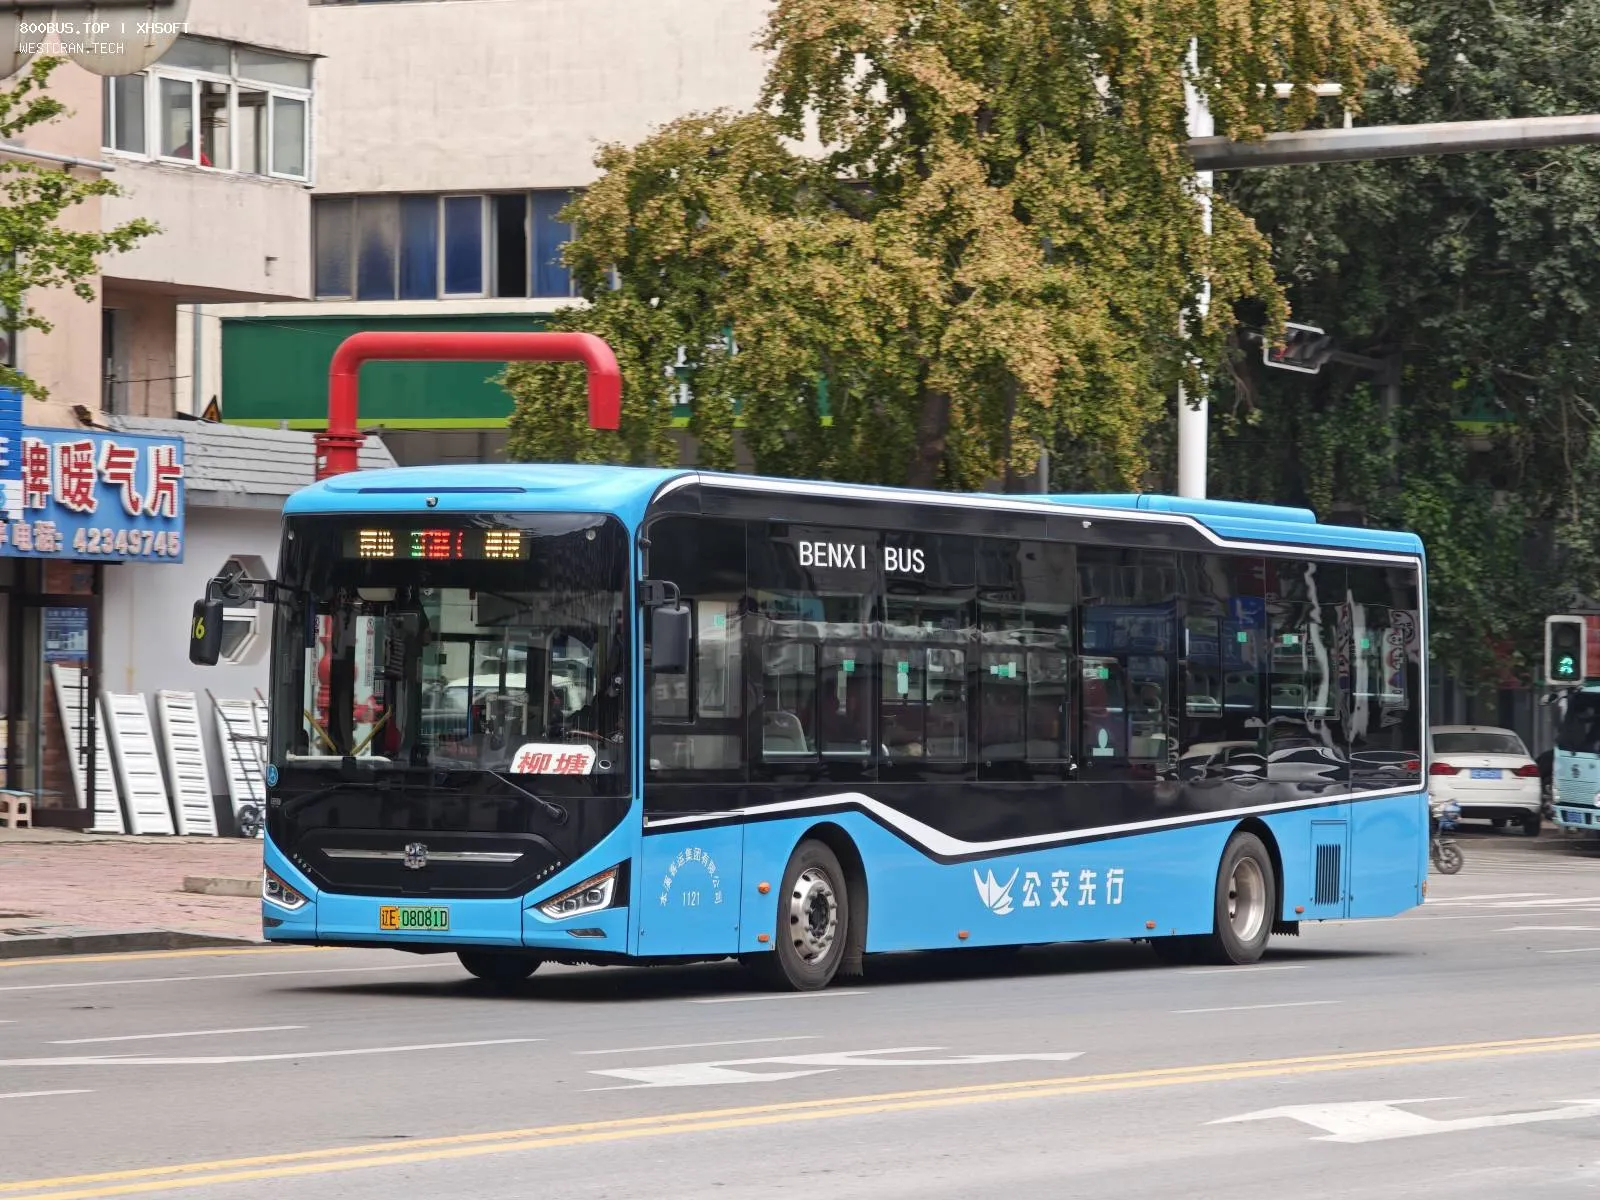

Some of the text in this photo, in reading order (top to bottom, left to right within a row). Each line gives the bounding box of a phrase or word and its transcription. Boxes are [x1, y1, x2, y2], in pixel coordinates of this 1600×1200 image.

[22, 437, 183, 517] 牌暖气片
[73, 527, 180, 557] 42349745
[799, 541, 925, 573] BENXI BUS
[682, 891, 700, 906] 1121
[1022, 868, 1125, 908] 公交先行
